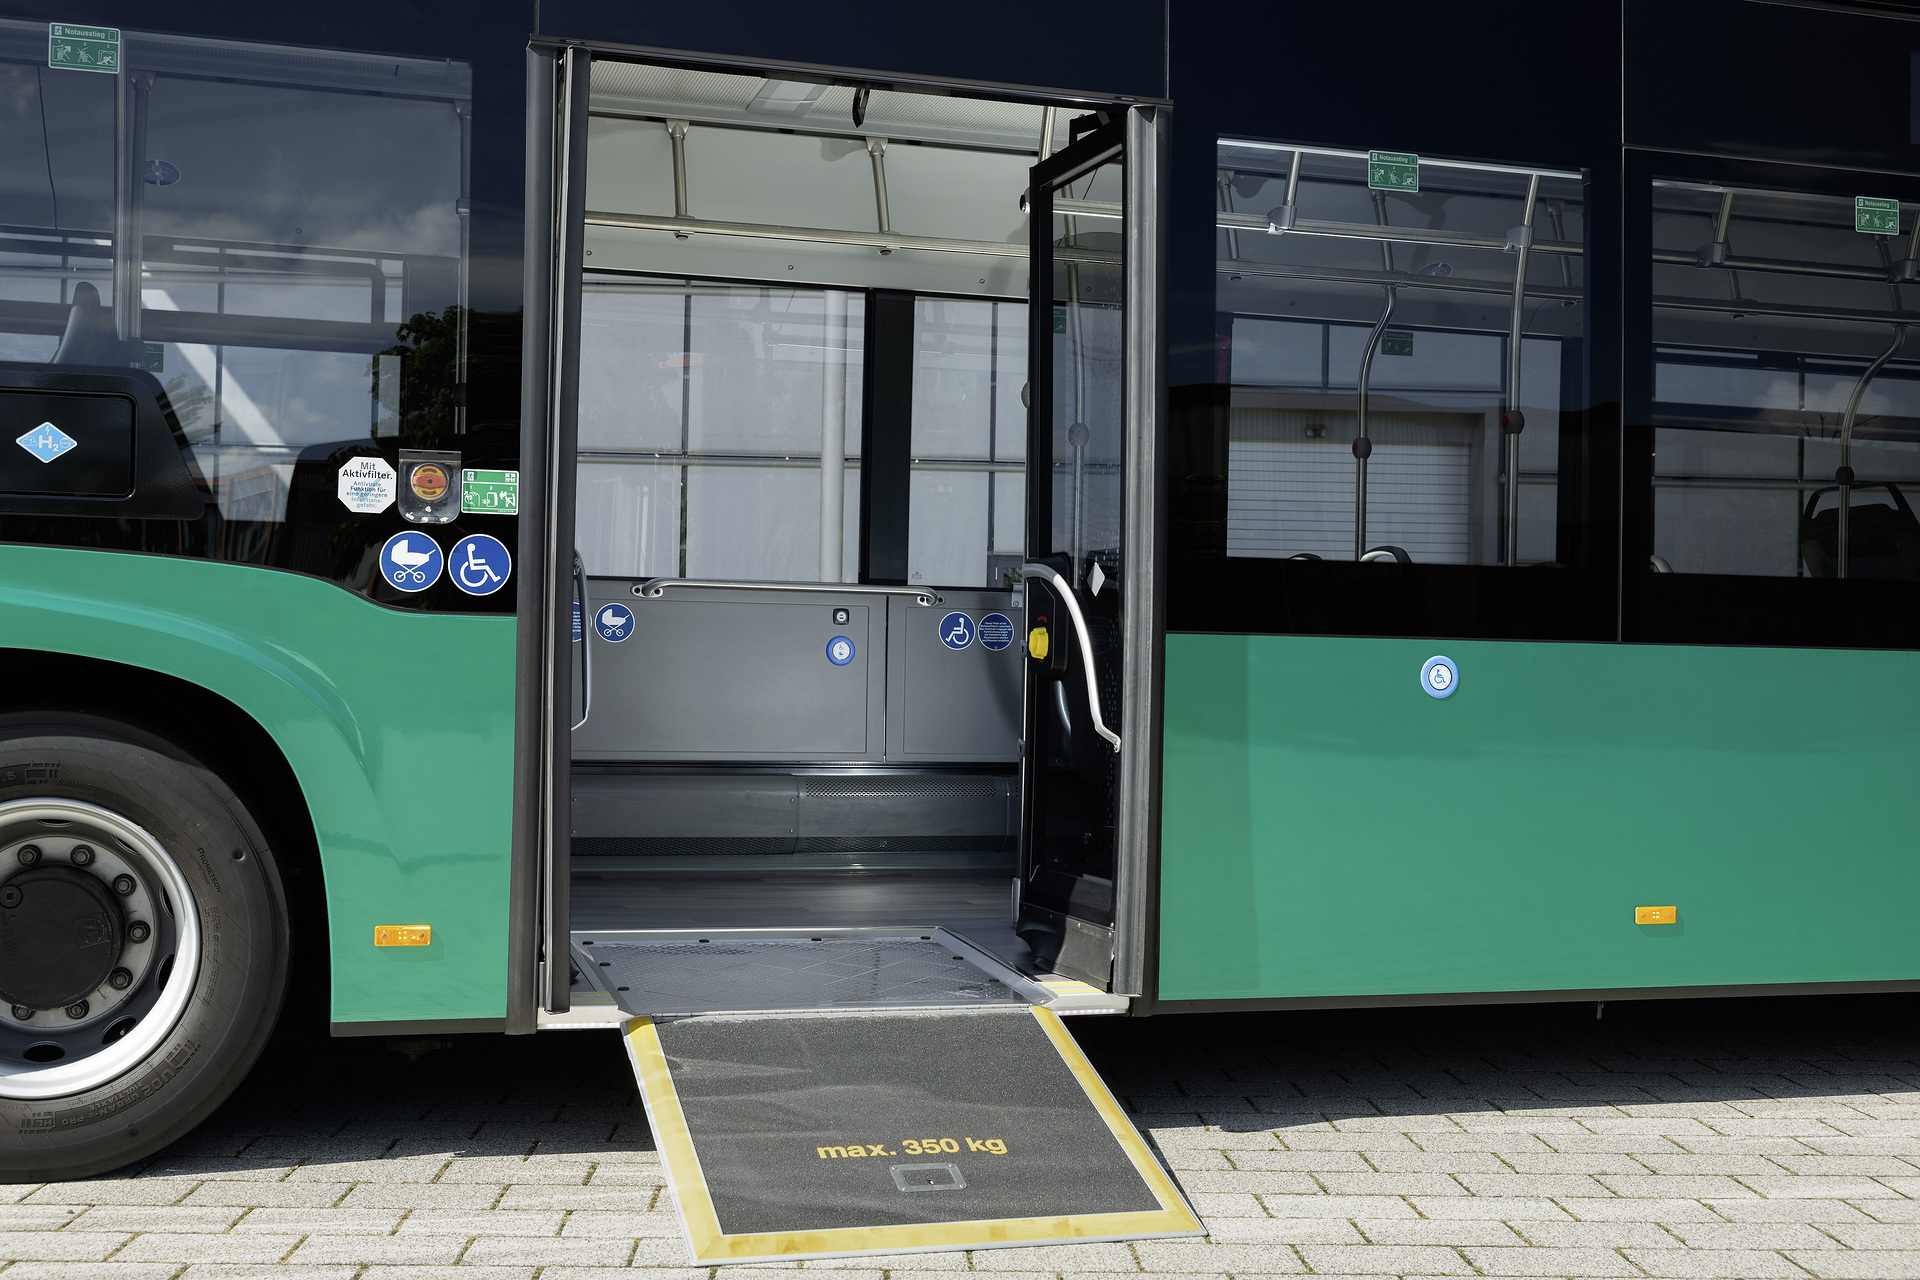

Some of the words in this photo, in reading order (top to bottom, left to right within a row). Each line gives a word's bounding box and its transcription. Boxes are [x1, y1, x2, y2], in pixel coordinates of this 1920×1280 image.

[64, 28, 105, 39] Notausstieg
[1380, 154, 1408, 164] Notausstieg
[360, 462, 376, 470] Mit
[342, 469, 393, 480] Aktivfilter.
[816, 1144, 897, 1160] max.
[902, 1138, 960, 1156] 350
[964, 1137, 1008, 1155] kg
